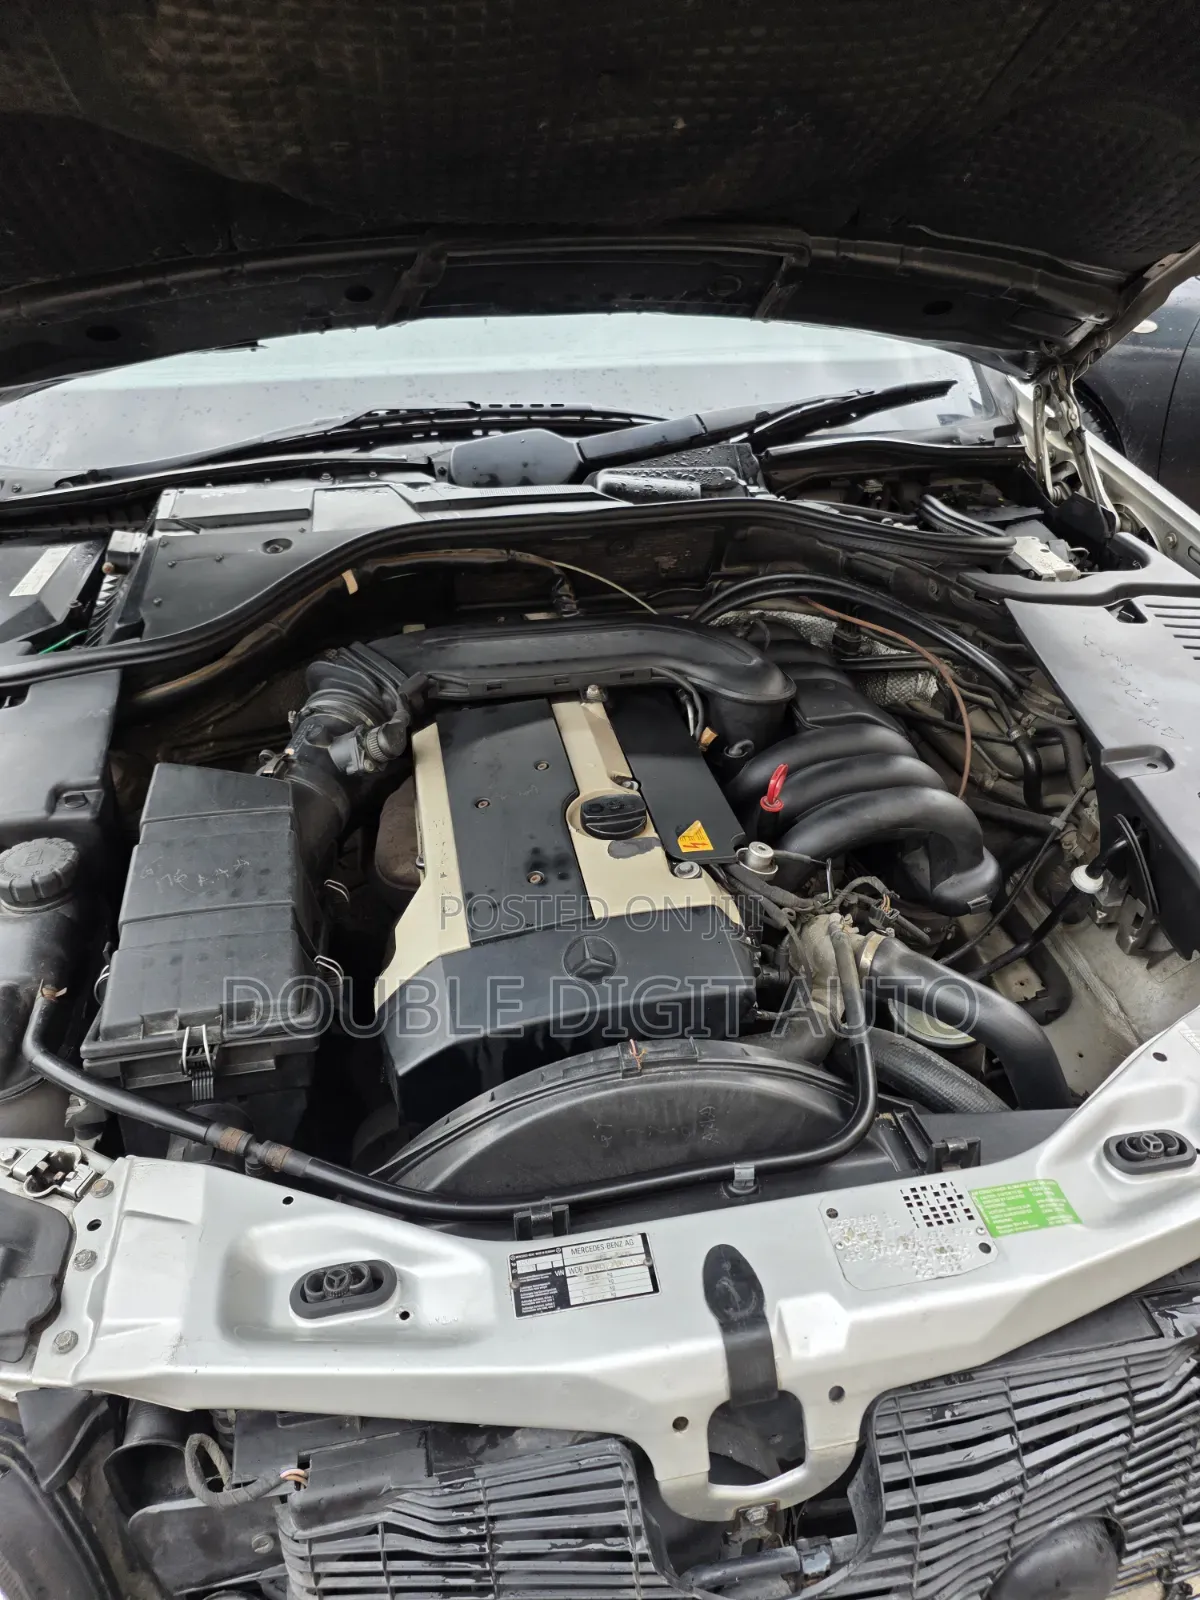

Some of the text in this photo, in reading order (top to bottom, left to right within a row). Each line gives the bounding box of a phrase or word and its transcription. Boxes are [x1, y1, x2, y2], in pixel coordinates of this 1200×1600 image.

[624, 1238, 635, 1246] AG
[554, 1269, 565, 1277] VIN
[568, 1265, 584, 1275] WDB
